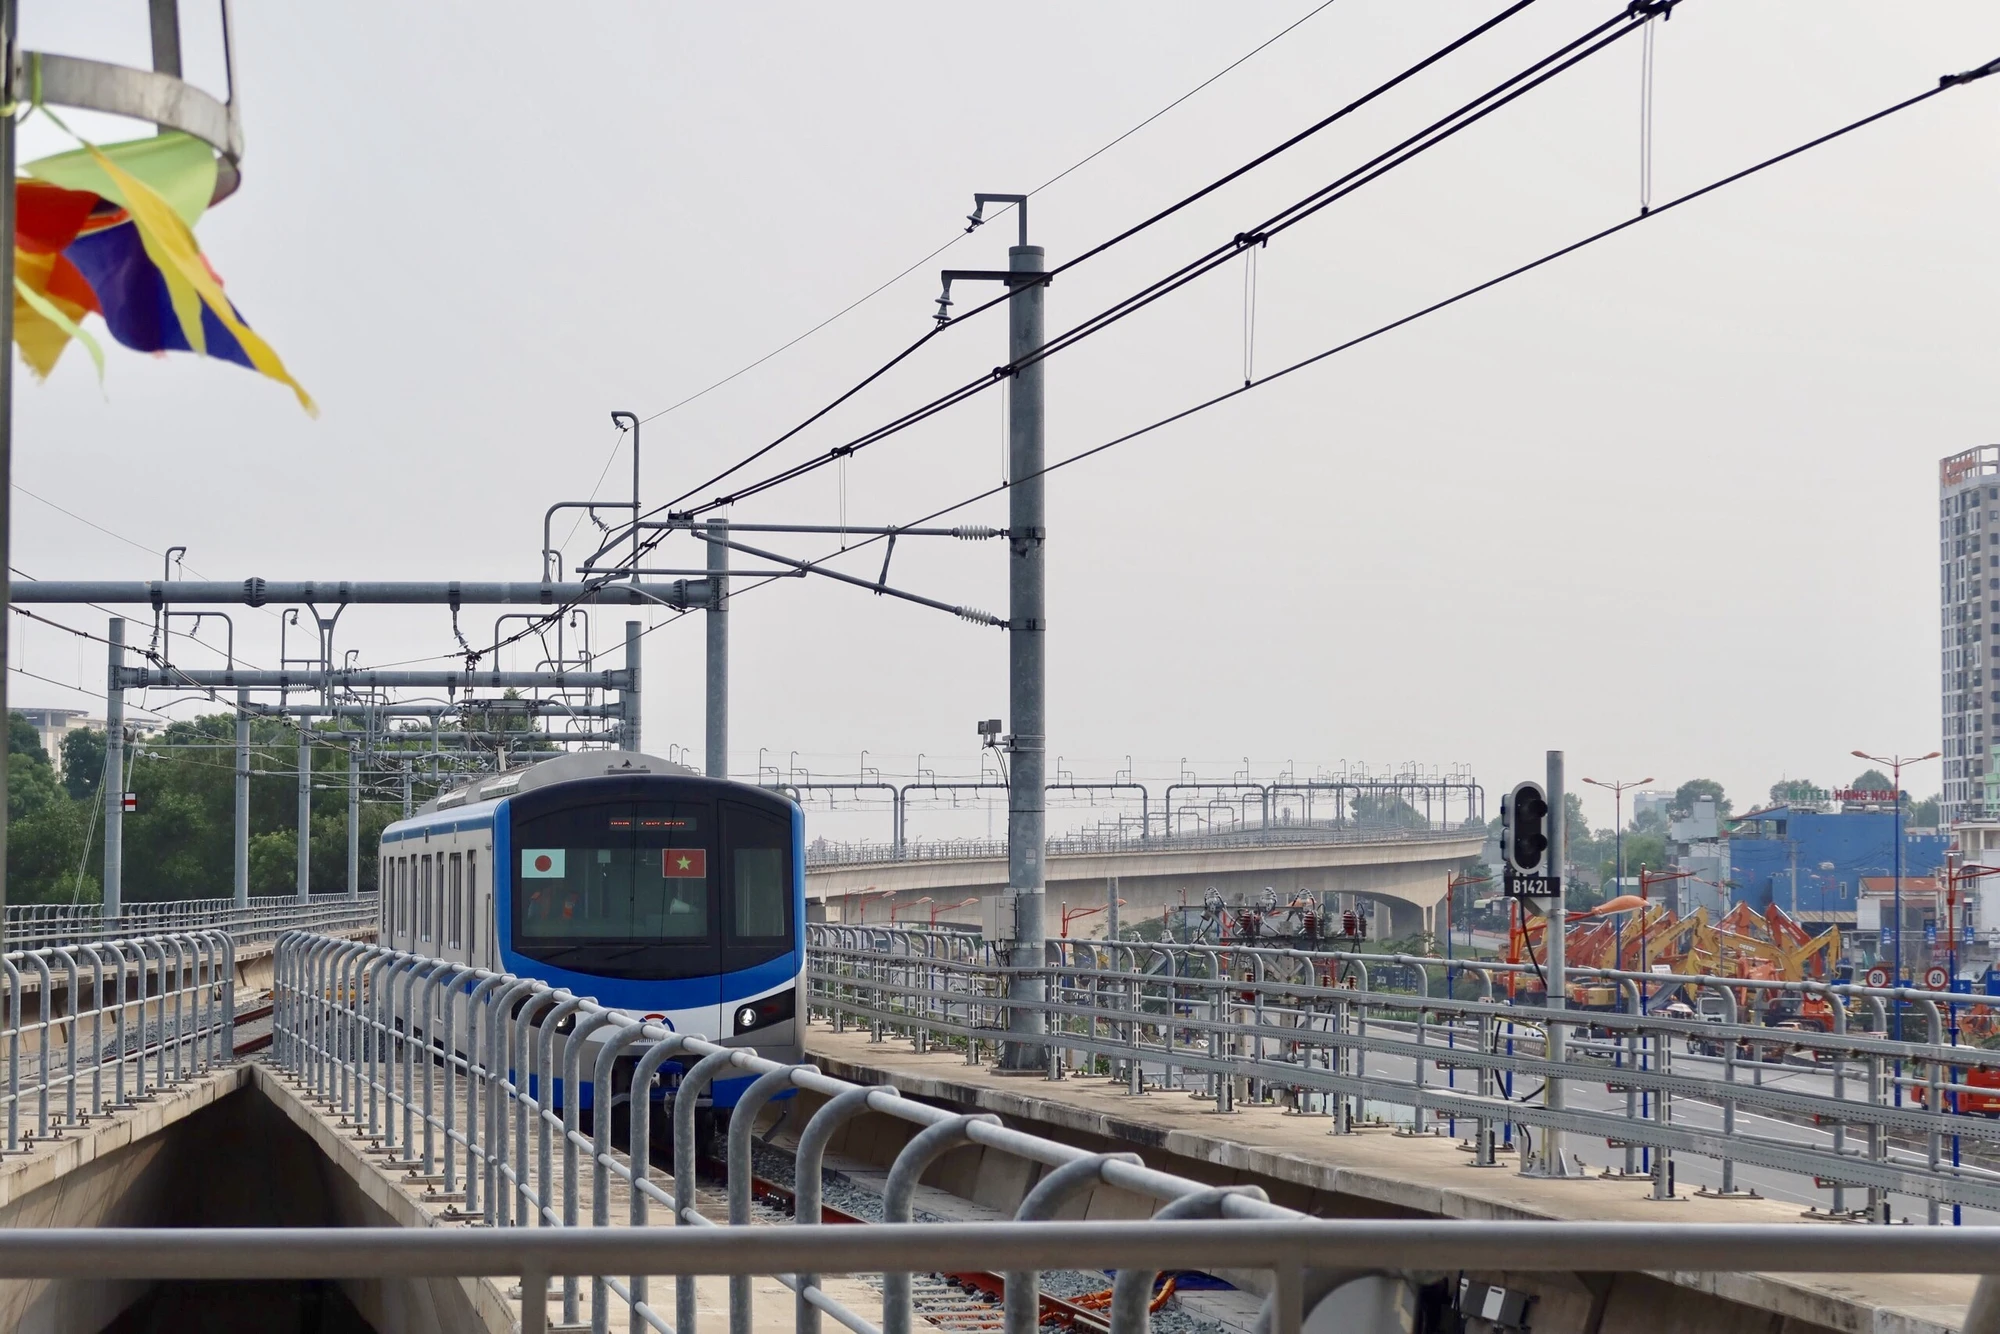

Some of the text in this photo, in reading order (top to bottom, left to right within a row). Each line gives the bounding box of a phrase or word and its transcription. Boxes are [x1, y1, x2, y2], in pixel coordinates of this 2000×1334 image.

[1899, 790, 1907, 801] 2
[1513, 879, 1552, 894] B142L
[1738, 943, 1756, 952] DEERE
[1872, 973, 1883, 984] 80
[1932, 973, 1942, 984] 60
